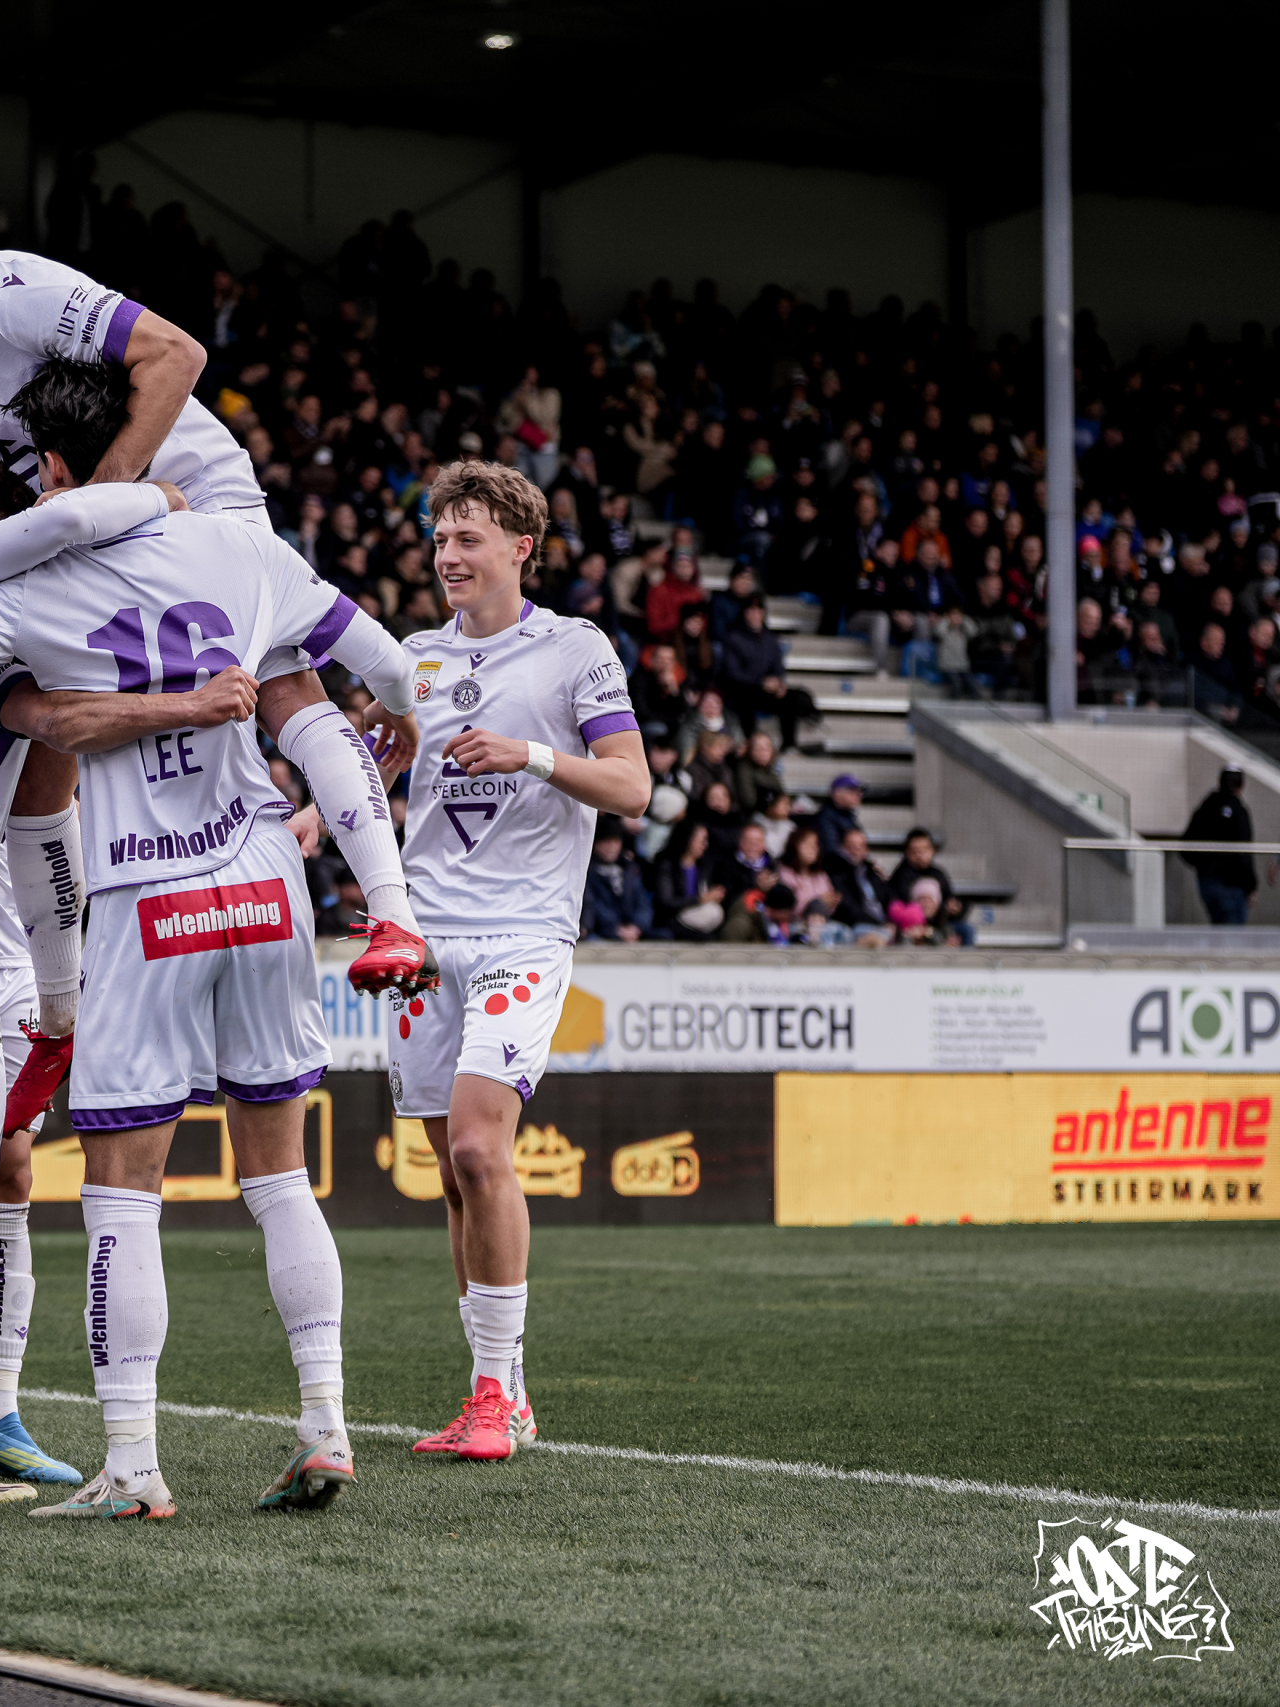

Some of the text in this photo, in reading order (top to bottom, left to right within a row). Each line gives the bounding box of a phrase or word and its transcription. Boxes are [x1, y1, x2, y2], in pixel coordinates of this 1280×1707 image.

[86, 600, 242, 694] 16
[138, 730, 204, 784] LEE
[619, 1002, 855, 1052] GEBROTECH
[1050, 1085, 1272, 1155] antenne
[1053, 1179, 1265, 1206] STEIERMARK
